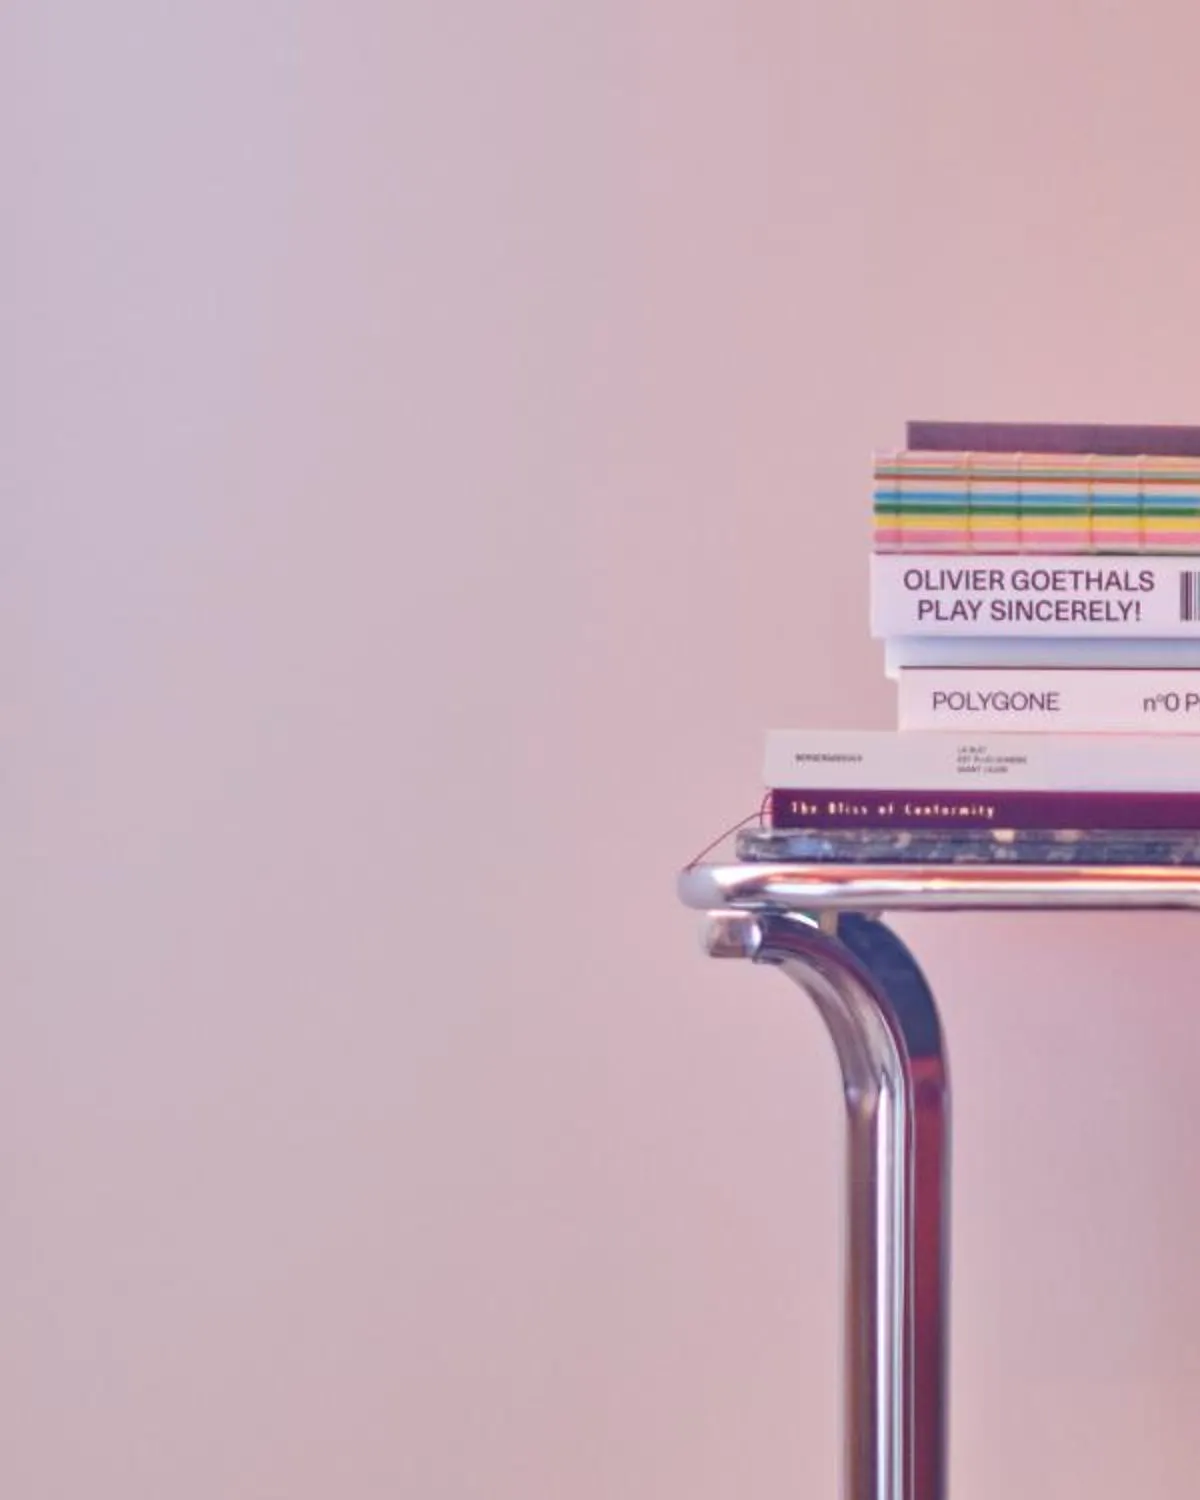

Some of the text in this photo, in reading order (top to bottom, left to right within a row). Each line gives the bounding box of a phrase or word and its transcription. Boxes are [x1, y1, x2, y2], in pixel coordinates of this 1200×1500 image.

[903, 569, 1155, 592] OLIVIER GOETHALS
[917, 600, 1142, 622] PLAY SINCERELY!
[932, 691, 1061, 711] POLYGONE
[791, 801, 995, 819] The Bliss of Conformity
